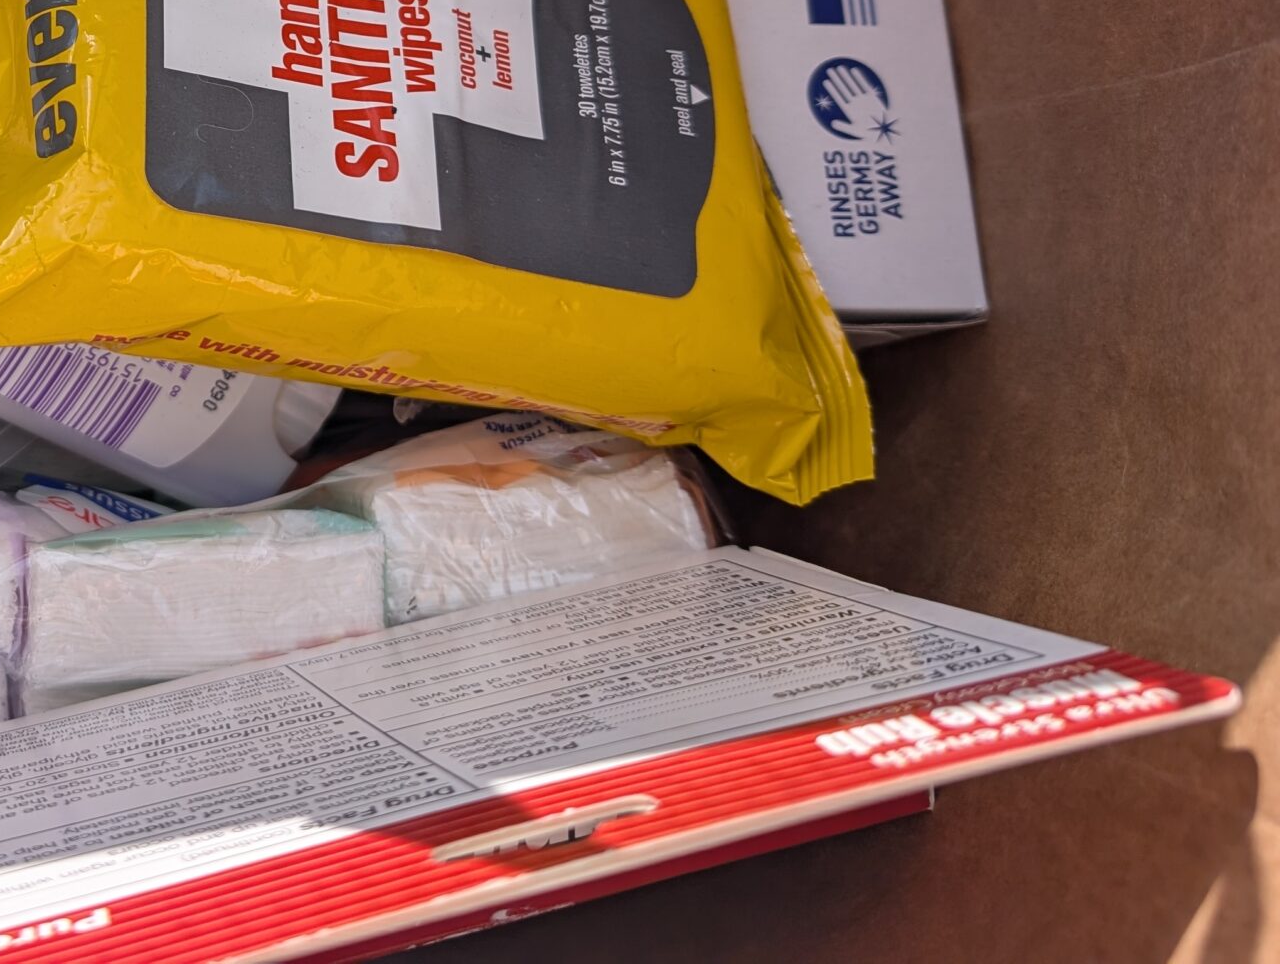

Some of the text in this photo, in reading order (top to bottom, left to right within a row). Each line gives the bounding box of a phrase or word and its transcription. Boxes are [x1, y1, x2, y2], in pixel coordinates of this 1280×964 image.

[452, 8, 476, 89] coconut
[475, 46, 491, 62] +
[490, 30, 513, 90] lemon
[573, 34, 597, 118] 30 towelettes
[595, 46, 619, 98] (15.2cm
[602, 103, 618, 115] in
[666, 50, 695, 136] peel and seal
[602, 117, 622, 145] 7.75
[608, 161, 625, 173] in
[609, 176, 626, 186] 6
[824, 151, 855, 237] RINSES
[849, 151, 879, 234] GERMS
[873, 151, 903, 219] AWAY
[200, 337, 280, 363] with
[290, 359, 505, 408] moisturizing
[170, 385, 181, 397] 8
[203, 369, 238, 411] 0604
[484, 422, 513, 433] PACK
[498, 428, 545, 450] TISSUE
[561, 609, 861, 681] Warnings For external use only.
[773, 645, 982, 698] Active ingredients
[871, 653, 1014, 690] Drug Facts
[238, 701, 323, 725] Inactive
[277, 711, 335, 728] Other
[816, 680, 1141, 755] Muscle Rub
[860, 688, 1173, 767] Ultra Strength
[106, 723, 231, 756] ingredients
[145, 725, 270, 758] information
[473, 741, 579, 770] Purpose
[28, 753, 98, 772] glycerin,
[169, 739, 353, 787] use only as directed
[258, 740, 380, 773] Directions
[360, 761, 415, 776] Keep
[295, 786, 315, 795] of
[321, 776, 355, 787] out
[204, 809, 223, 818] of
[230, 792, 289, 809] reach
[110, 815, 196, 840] children
[175, 786, 455, 862] Drug Facts (continued)
[23, 844, 78, 863] avoid
